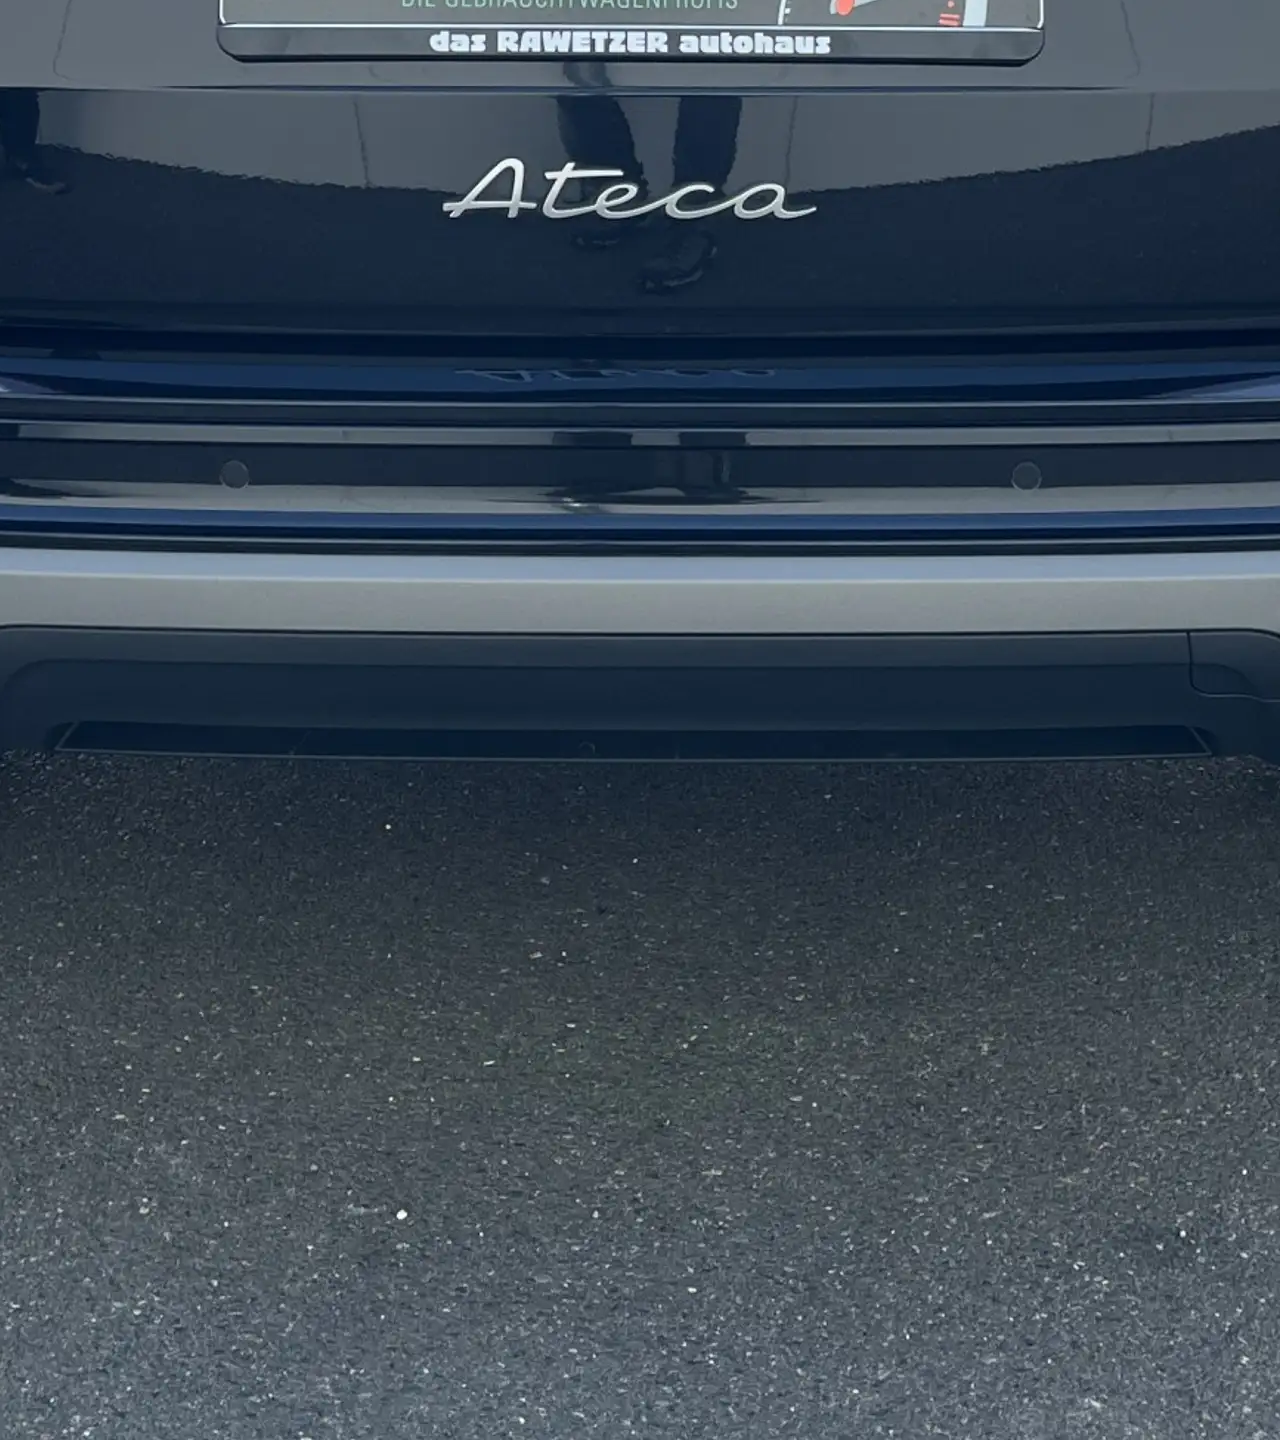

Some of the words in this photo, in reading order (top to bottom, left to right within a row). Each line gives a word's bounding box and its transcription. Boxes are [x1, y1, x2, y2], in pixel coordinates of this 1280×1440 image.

[429, 30, 487, 52] das
[497, 30, 668, 53] RAWETZER
[679, 32, 831, 54] autohaus
[442, 158, 817, 220] Ateca
